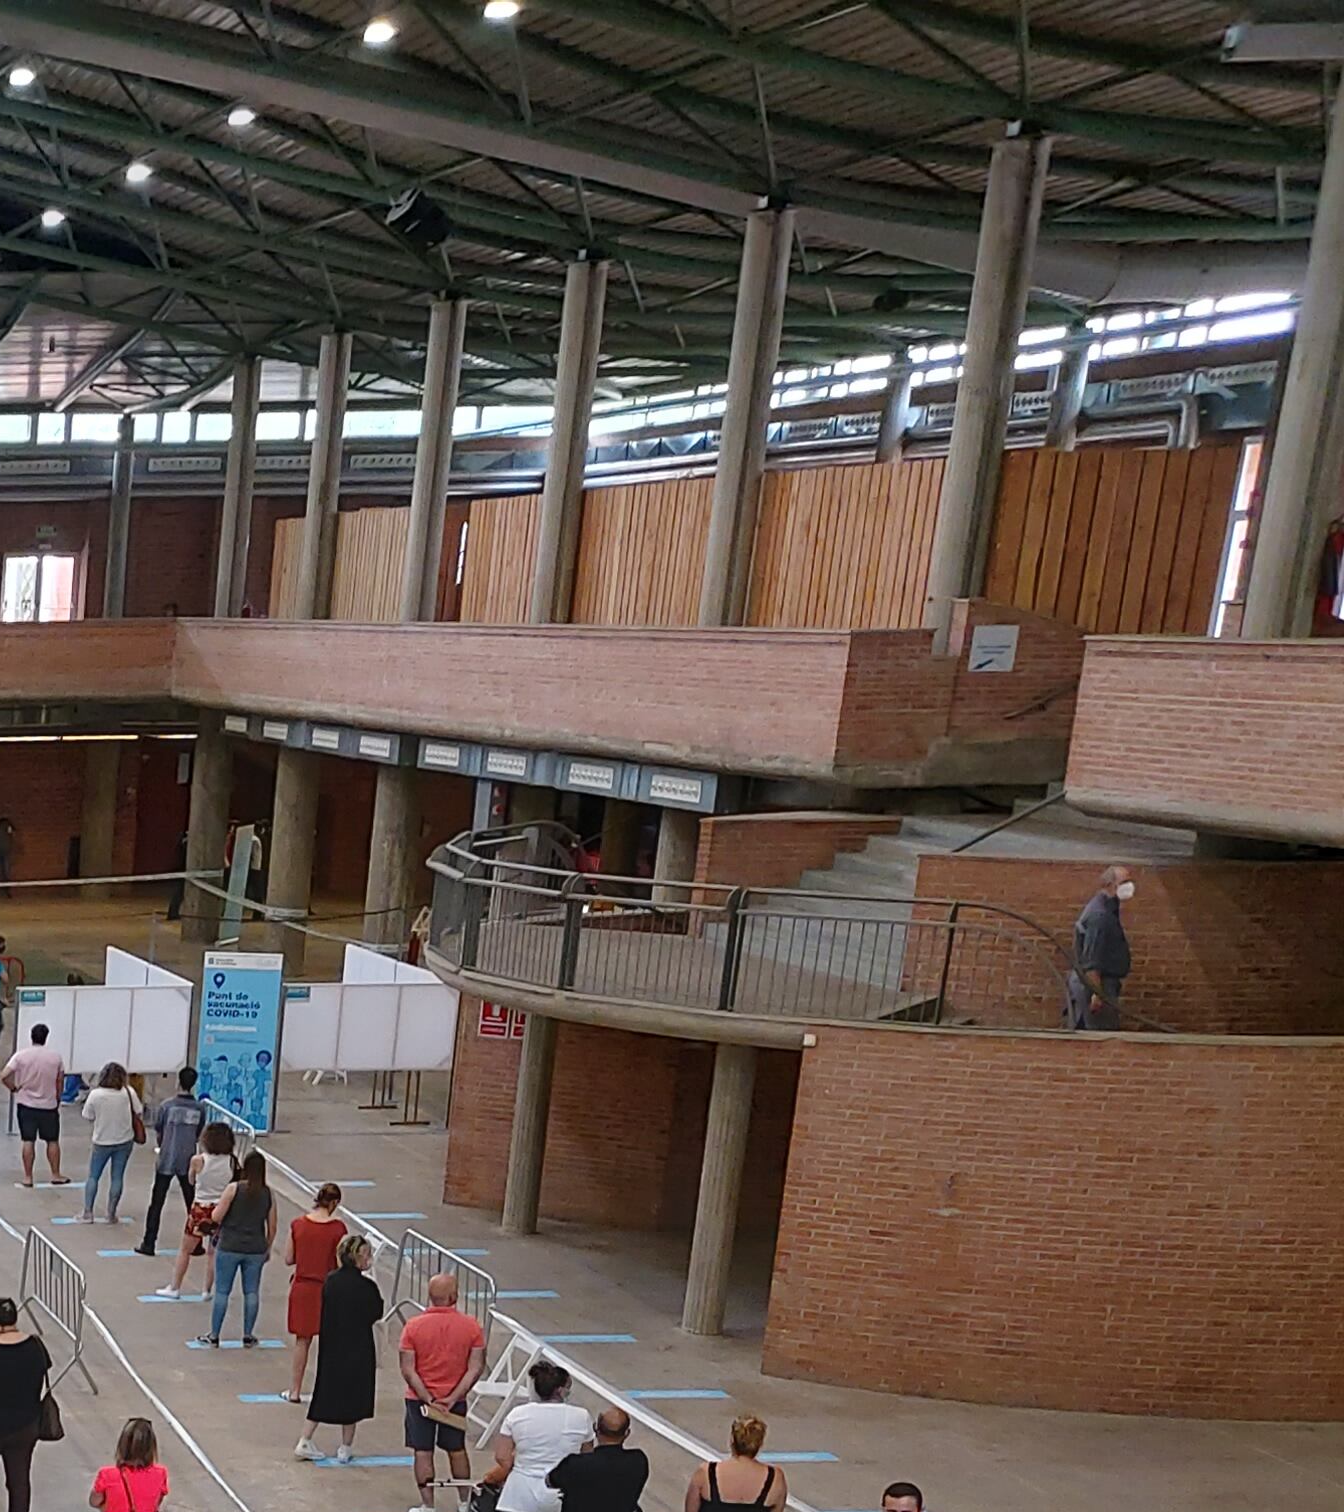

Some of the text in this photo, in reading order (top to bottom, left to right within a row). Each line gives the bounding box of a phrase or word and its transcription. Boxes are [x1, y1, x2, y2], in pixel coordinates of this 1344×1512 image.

[207, 991, 249, 1000] Punt de
[207, 1001, 261, 1010] vacunació
[206, 1009, 258, 1019] COVID-19
